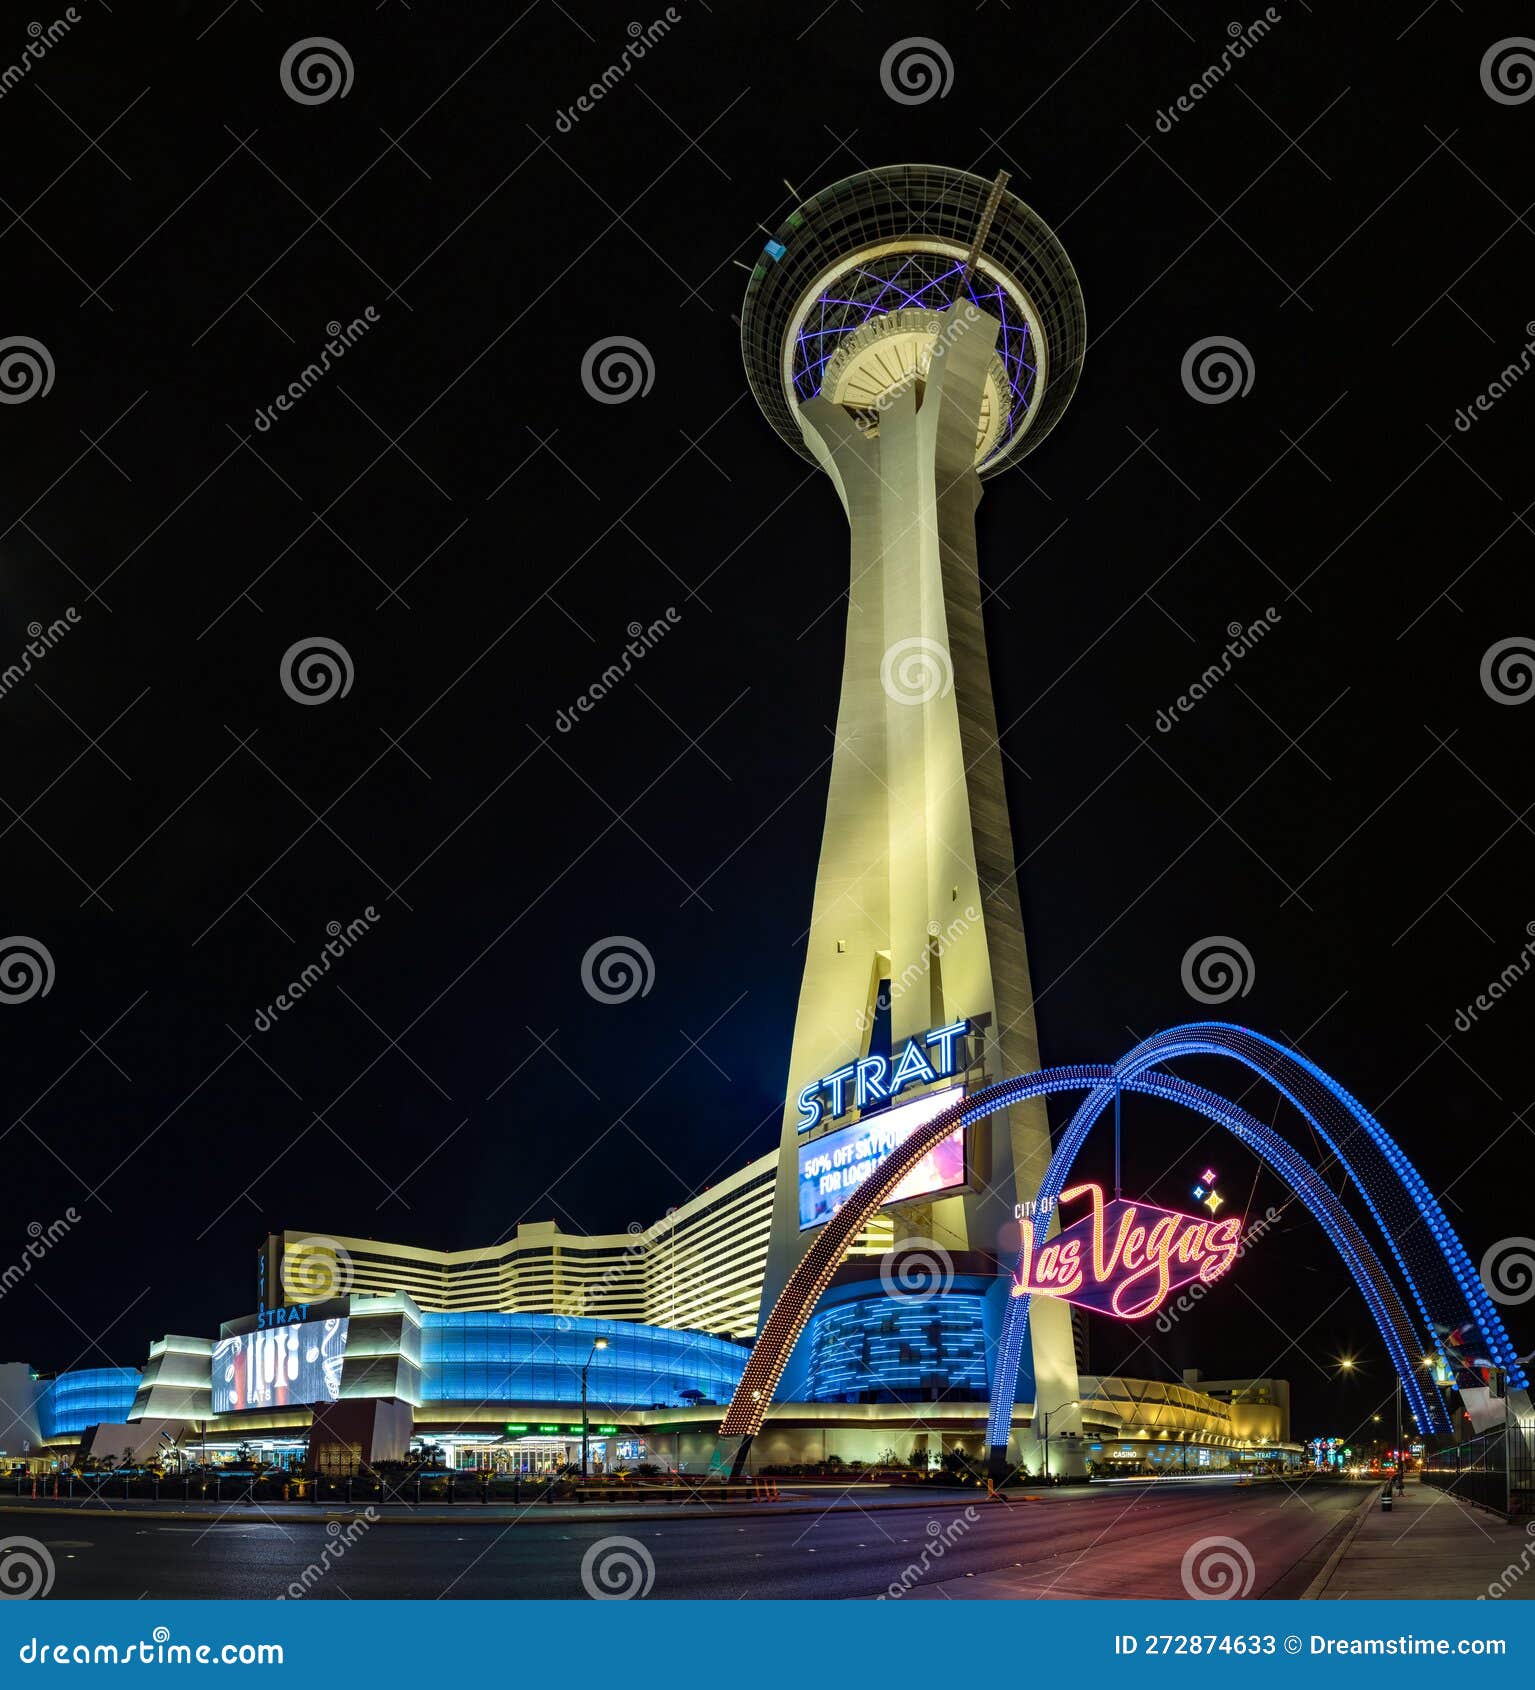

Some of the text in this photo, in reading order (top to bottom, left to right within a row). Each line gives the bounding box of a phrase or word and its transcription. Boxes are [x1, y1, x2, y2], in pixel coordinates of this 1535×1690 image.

[797, 1020, 969, 1134] STRAT
[804, 1153, 831, 1179] 50%
[833, 1142, 854, 1168] OFF
[820, 1171, 841, 1195] FOR
[1014, 1195, 1056, 1219] CITY OF
[1011, 1183, 1242, 1319] Las Vegas
[257, 1303, 311, 1329] STRAT
[1113, 1451, 1137, 1459] CASINO
